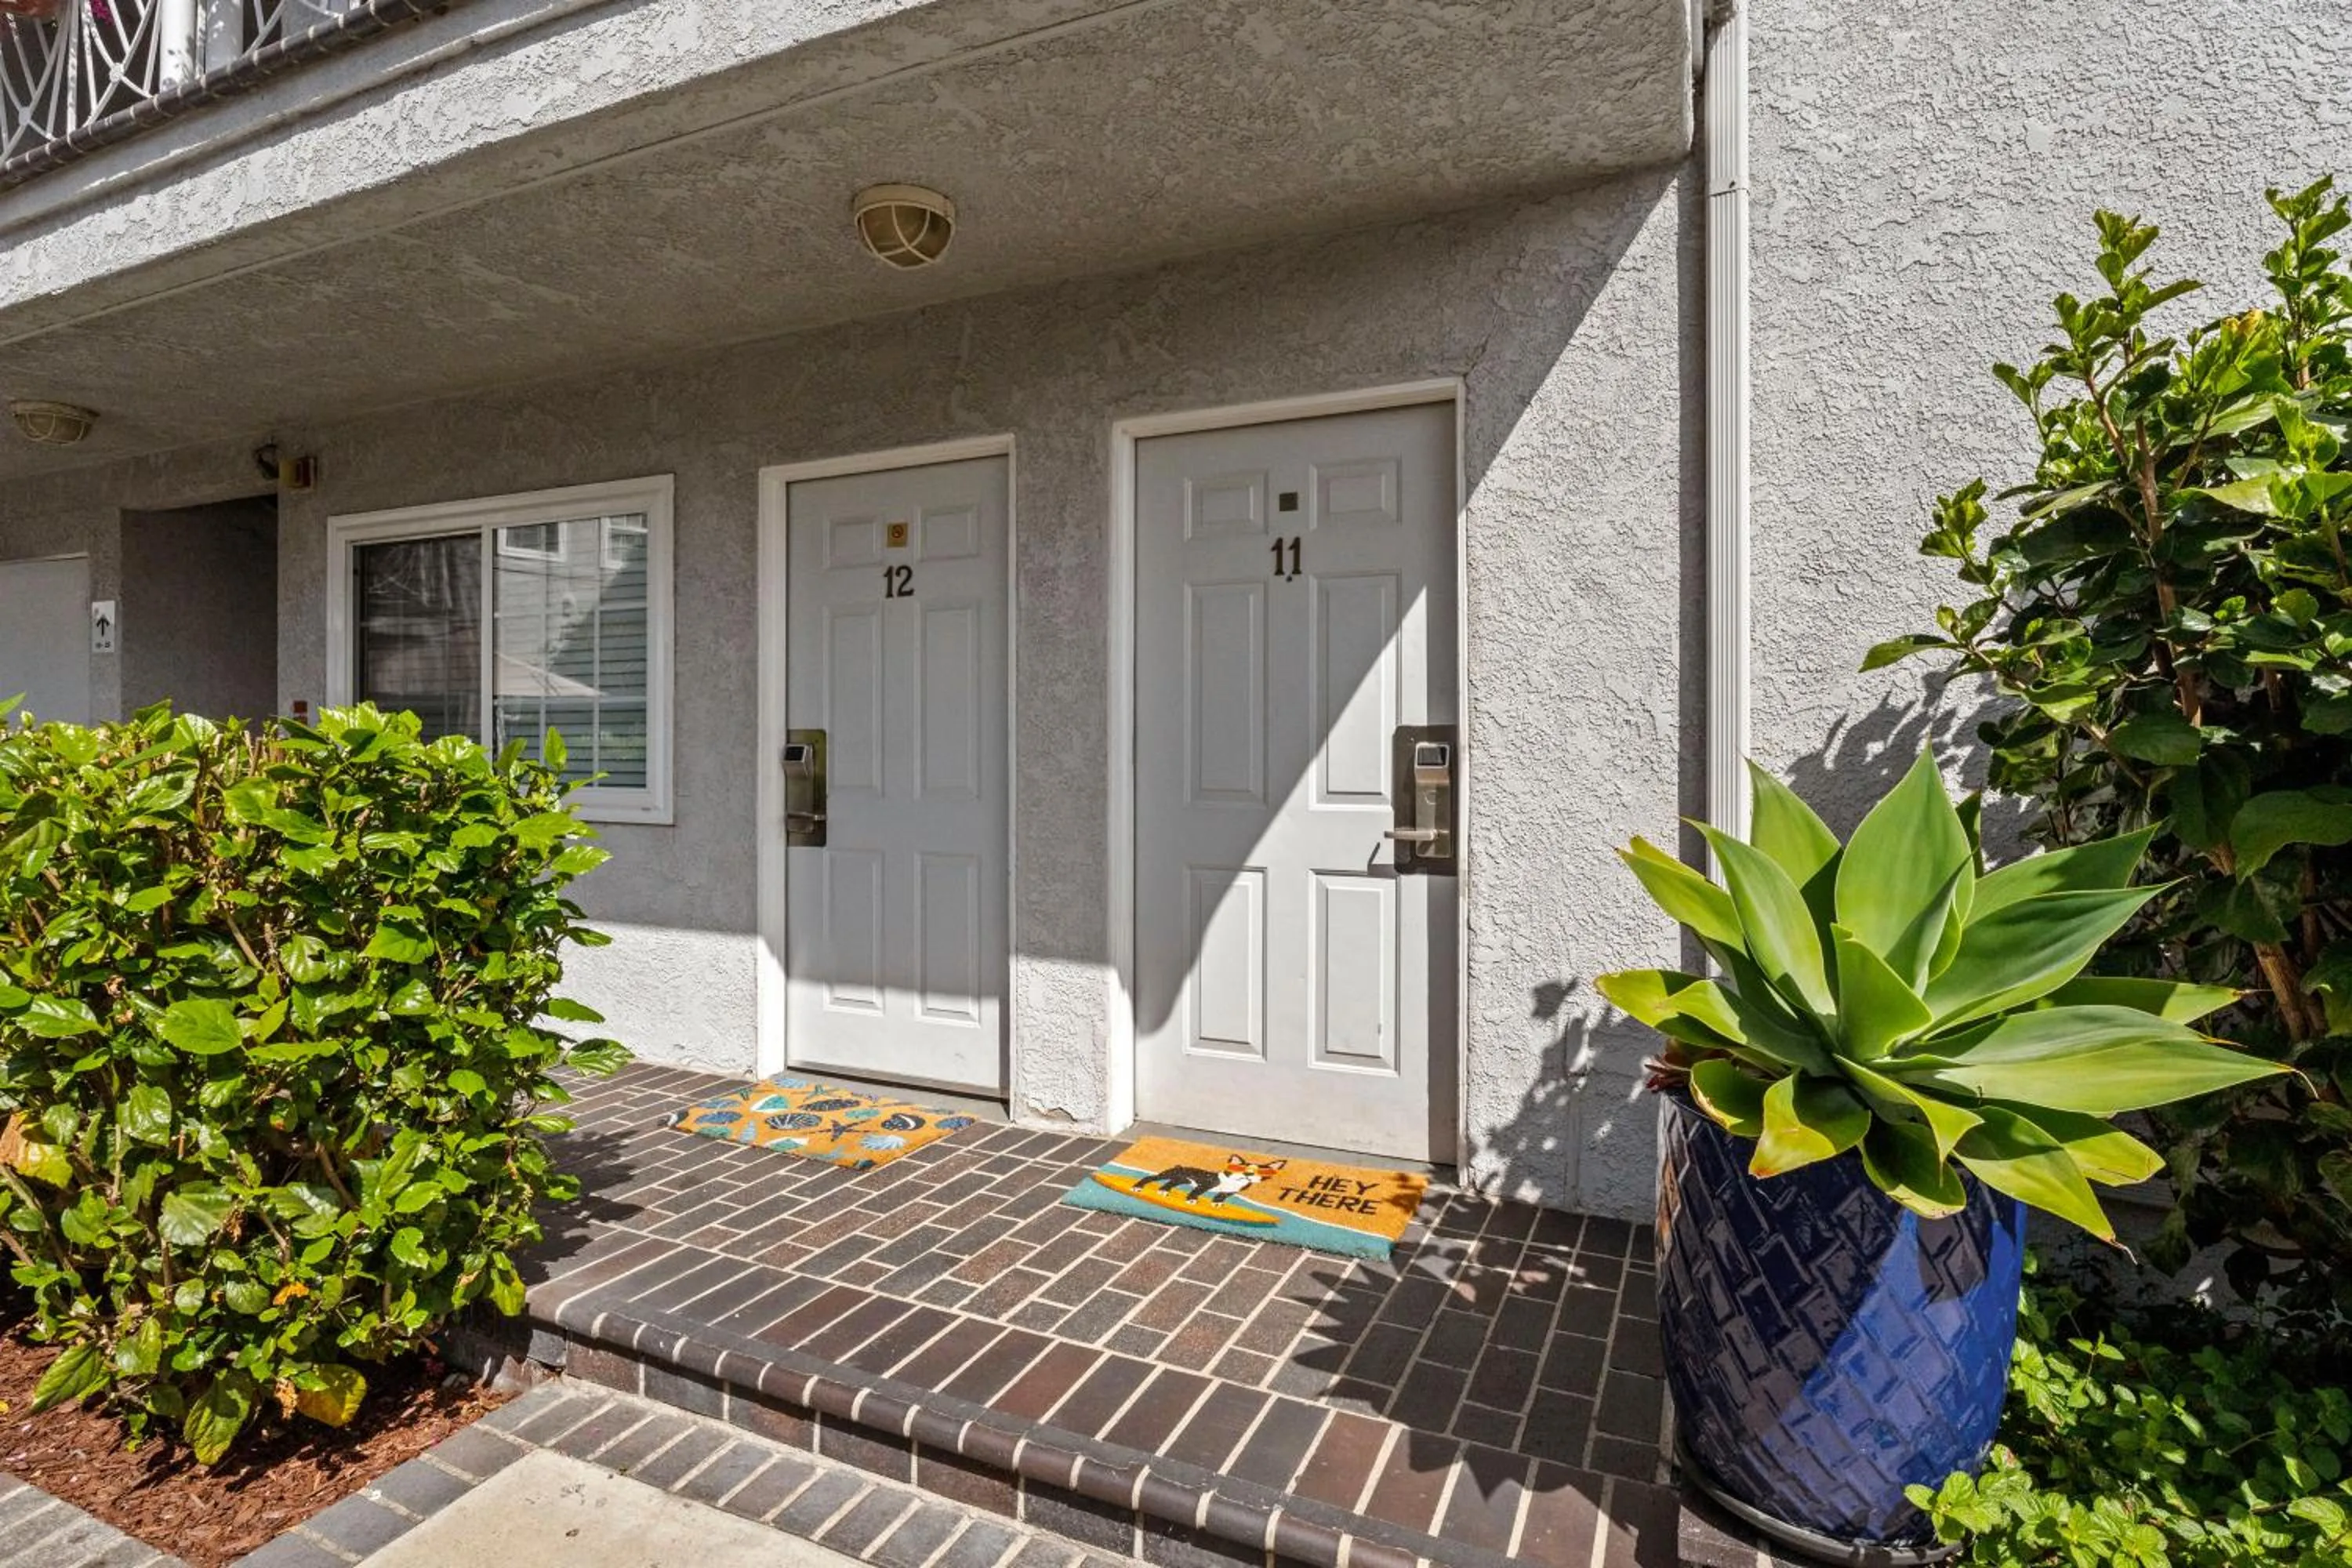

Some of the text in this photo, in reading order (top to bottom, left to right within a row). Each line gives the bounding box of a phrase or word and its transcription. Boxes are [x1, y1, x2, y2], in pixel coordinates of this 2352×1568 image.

[1271, 536, 1301, 575] 11
[884, 565, 914, 598] 12
[1279, 1186, 1381, 1214] THERE
[1308, 1175, 1380, 1195] HEY
